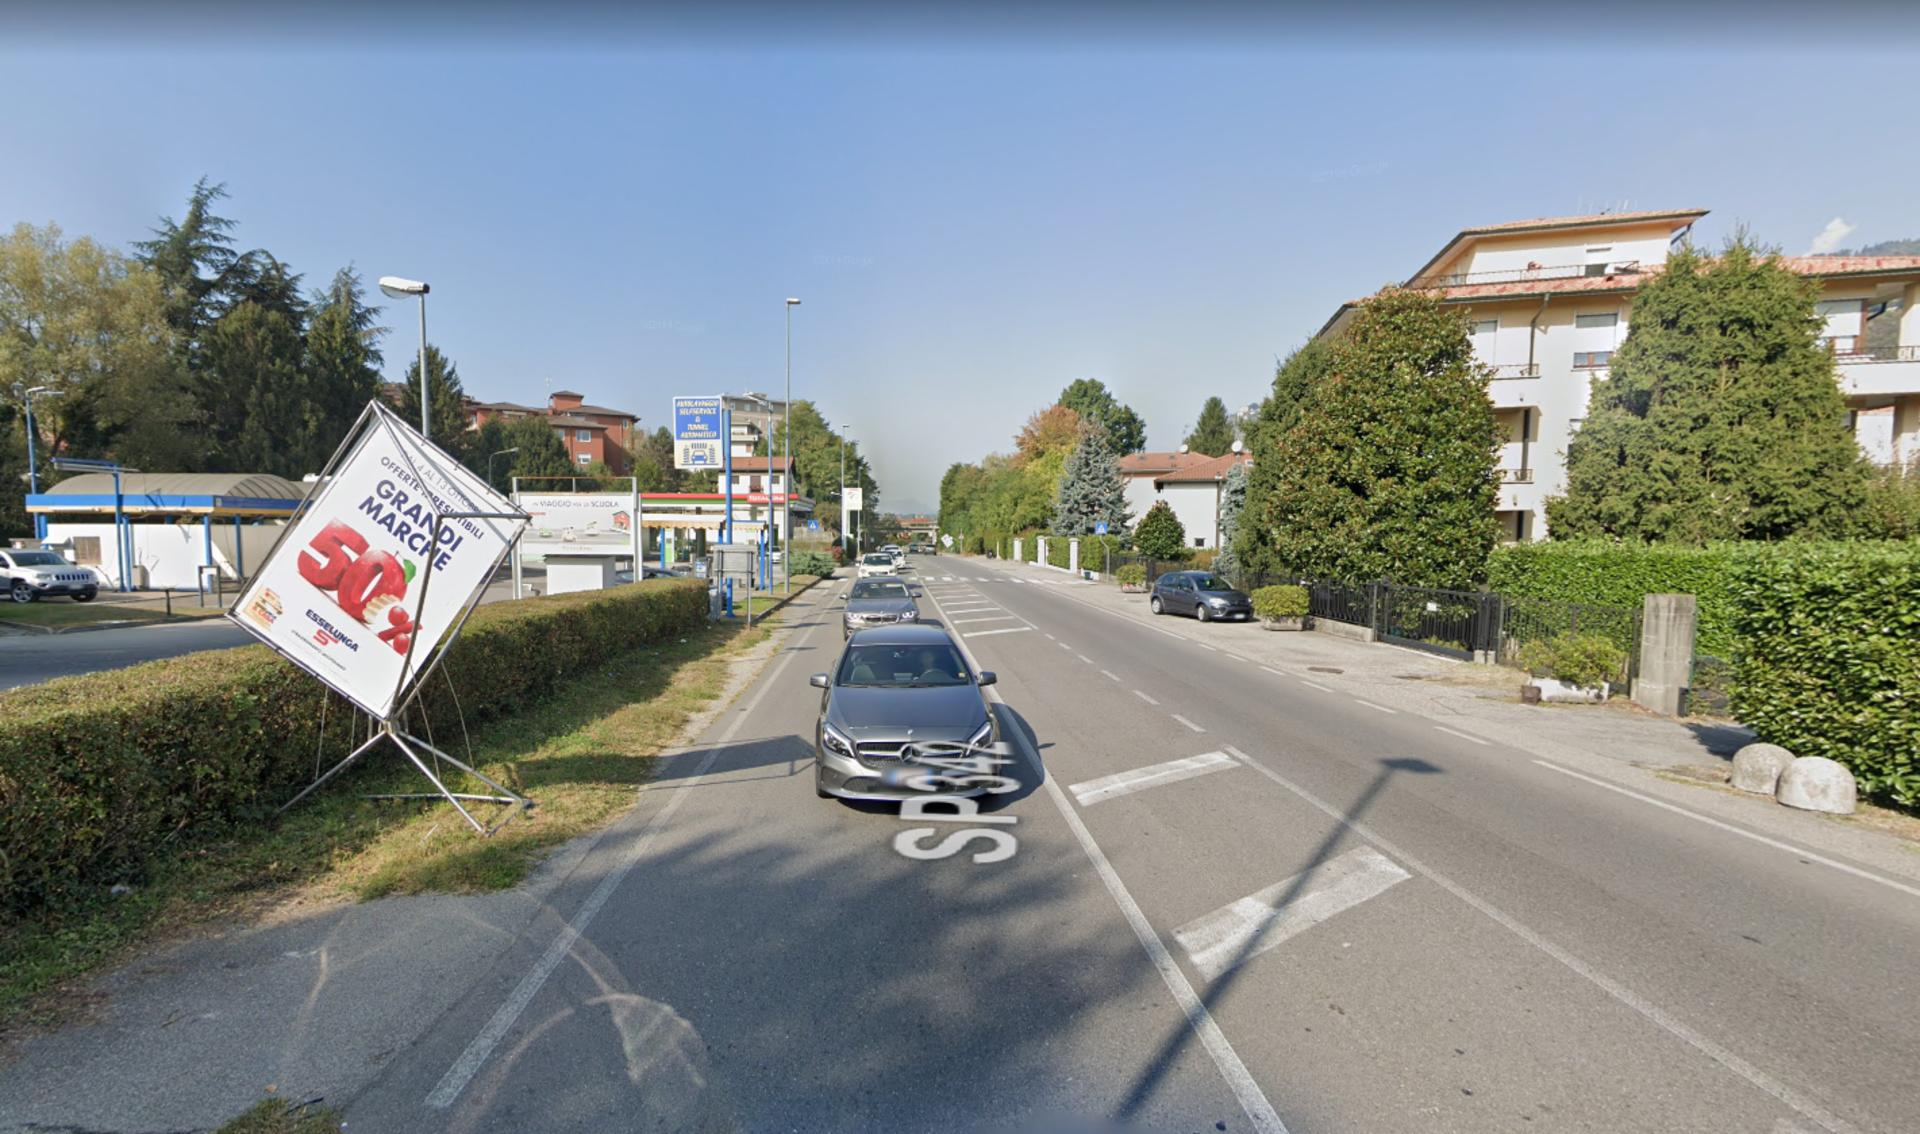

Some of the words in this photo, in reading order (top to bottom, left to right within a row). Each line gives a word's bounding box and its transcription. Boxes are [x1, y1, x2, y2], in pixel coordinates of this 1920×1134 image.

[380, 456, 421, 492] OFFERTE
[358, 495, 452, 571] MARCHE
[376, 479, 464, 552] GRANDI
[305, 608, 359, 652] ESSELUNGA
